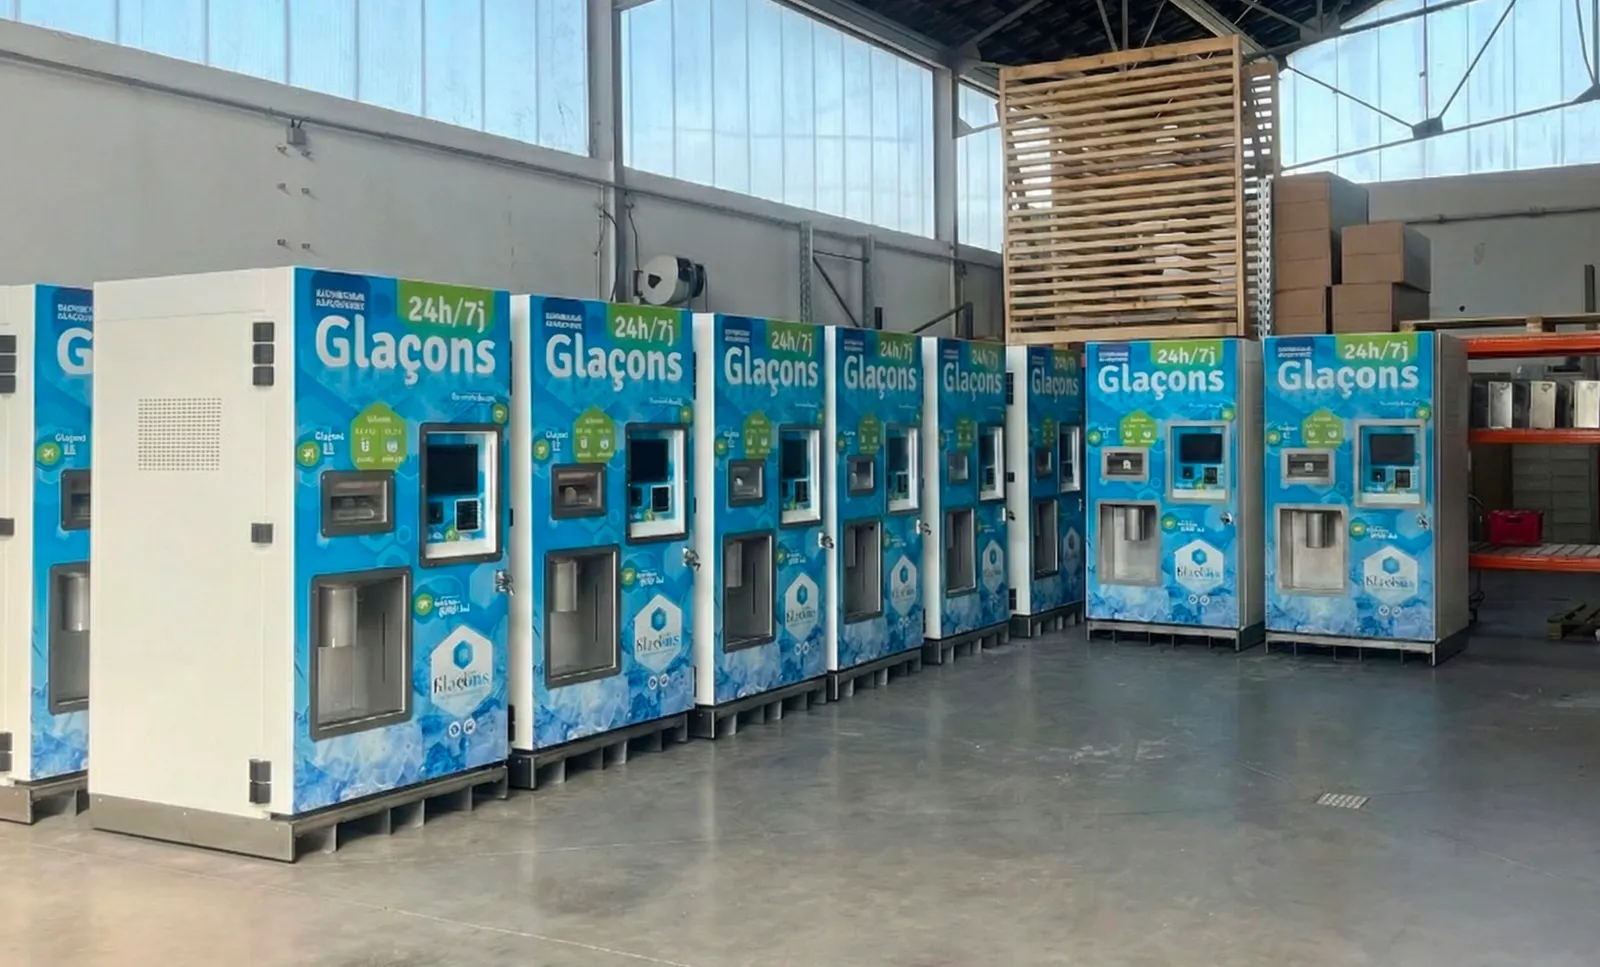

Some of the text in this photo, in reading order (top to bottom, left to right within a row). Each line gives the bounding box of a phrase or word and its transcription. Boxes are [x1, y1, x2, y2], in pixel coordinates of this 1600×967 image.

[408, 295, 486, 333] 24h/7j
[614, 315, 674, 347] 24h/7j
[315, 314, 497, 386] Glaçons
[545, 332, 684, 392] Glaçons
[771, 330, 813, 357] 24h/7j
[1157, 346, 1216, 367] 24h/7j
[1344, 341, 1409, 363] 24h/7j
[724, 346, 819, 397] Glaçons
[843, 354, 917, 400] Glaçons
[943, 361, 1002, 402] Glaçons
[1031, 367, 1079, 403] Glaçons
[1097, 363, 1225, 401] Glaçons
[1278, 359, 1420, 399] Glaçons
